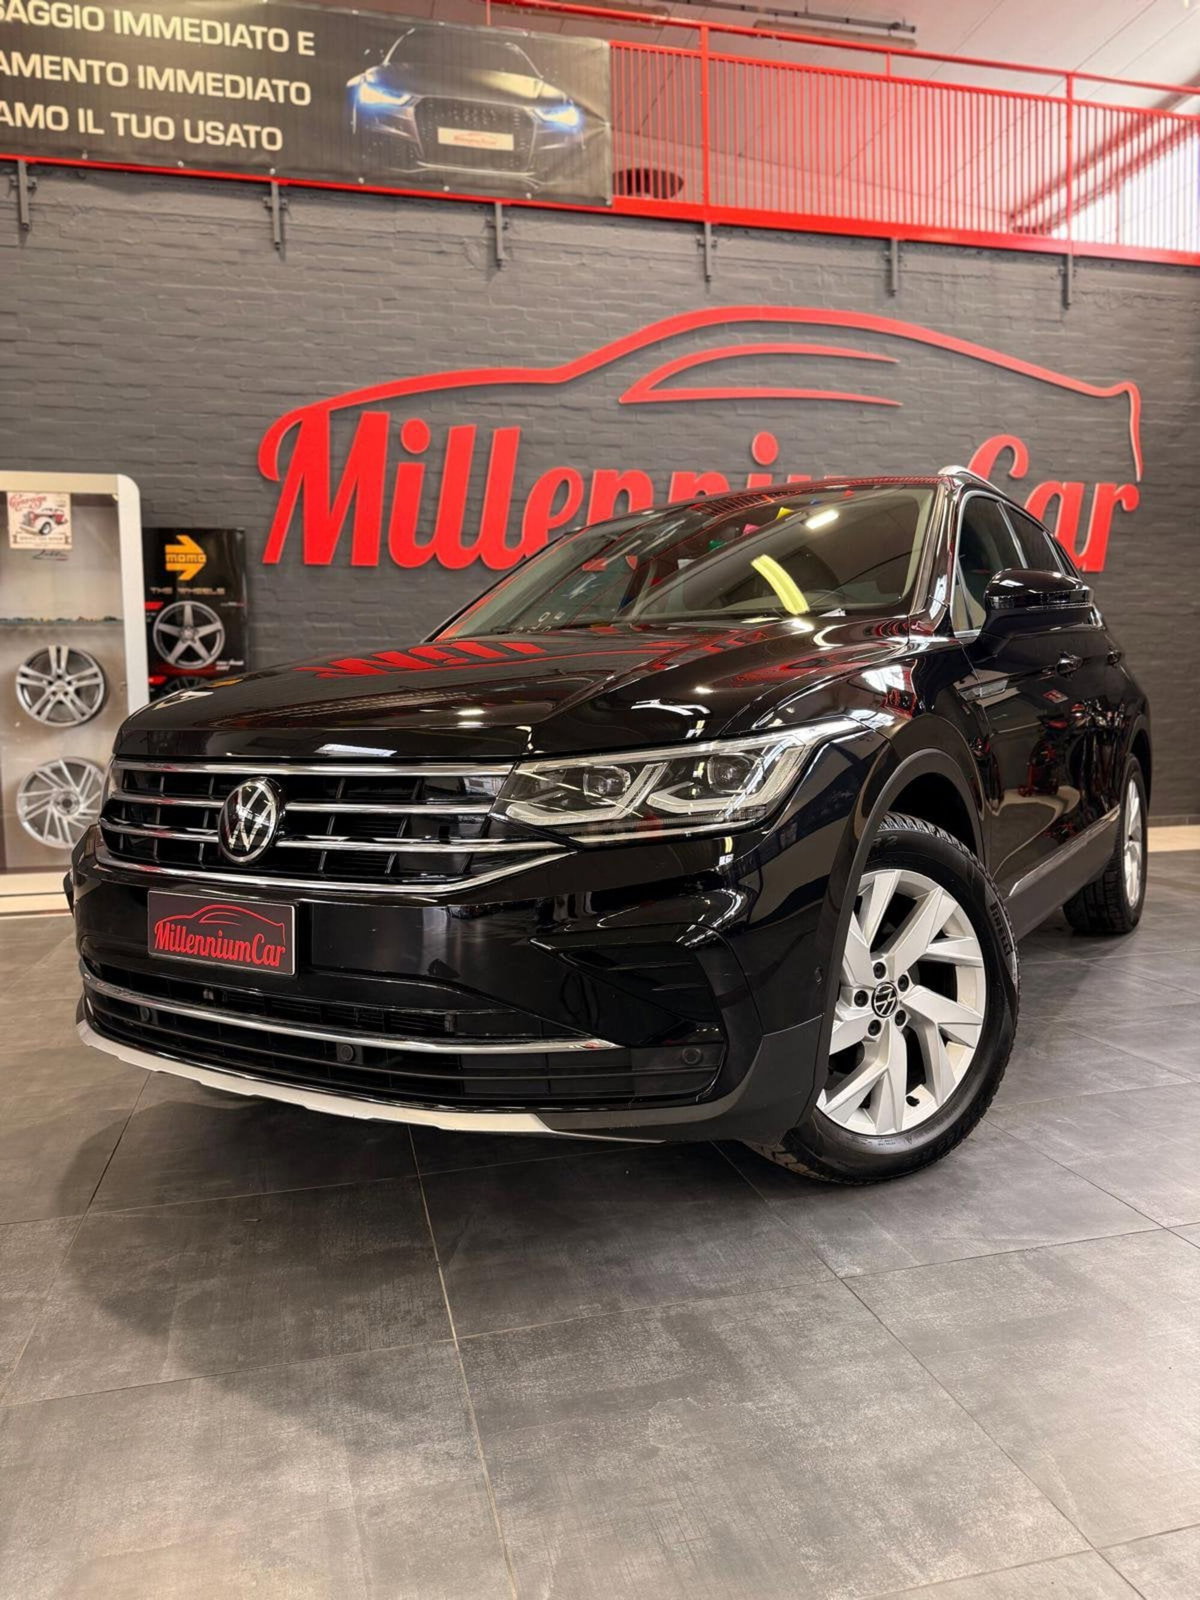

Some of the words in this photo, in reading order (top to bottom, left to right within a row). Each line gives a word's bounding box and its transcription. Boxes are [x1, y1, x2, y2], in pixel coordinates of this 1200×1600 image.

[113, 9, 289, 53] IMMEDIATO
[297, 31, 316, 56] E
[137, 65, 311, 106] IMMEDIATO
[78, 108, 105, 135] IL
[110, 112, 175, 141] TUO
[183, 119, 283, 151] USATO
